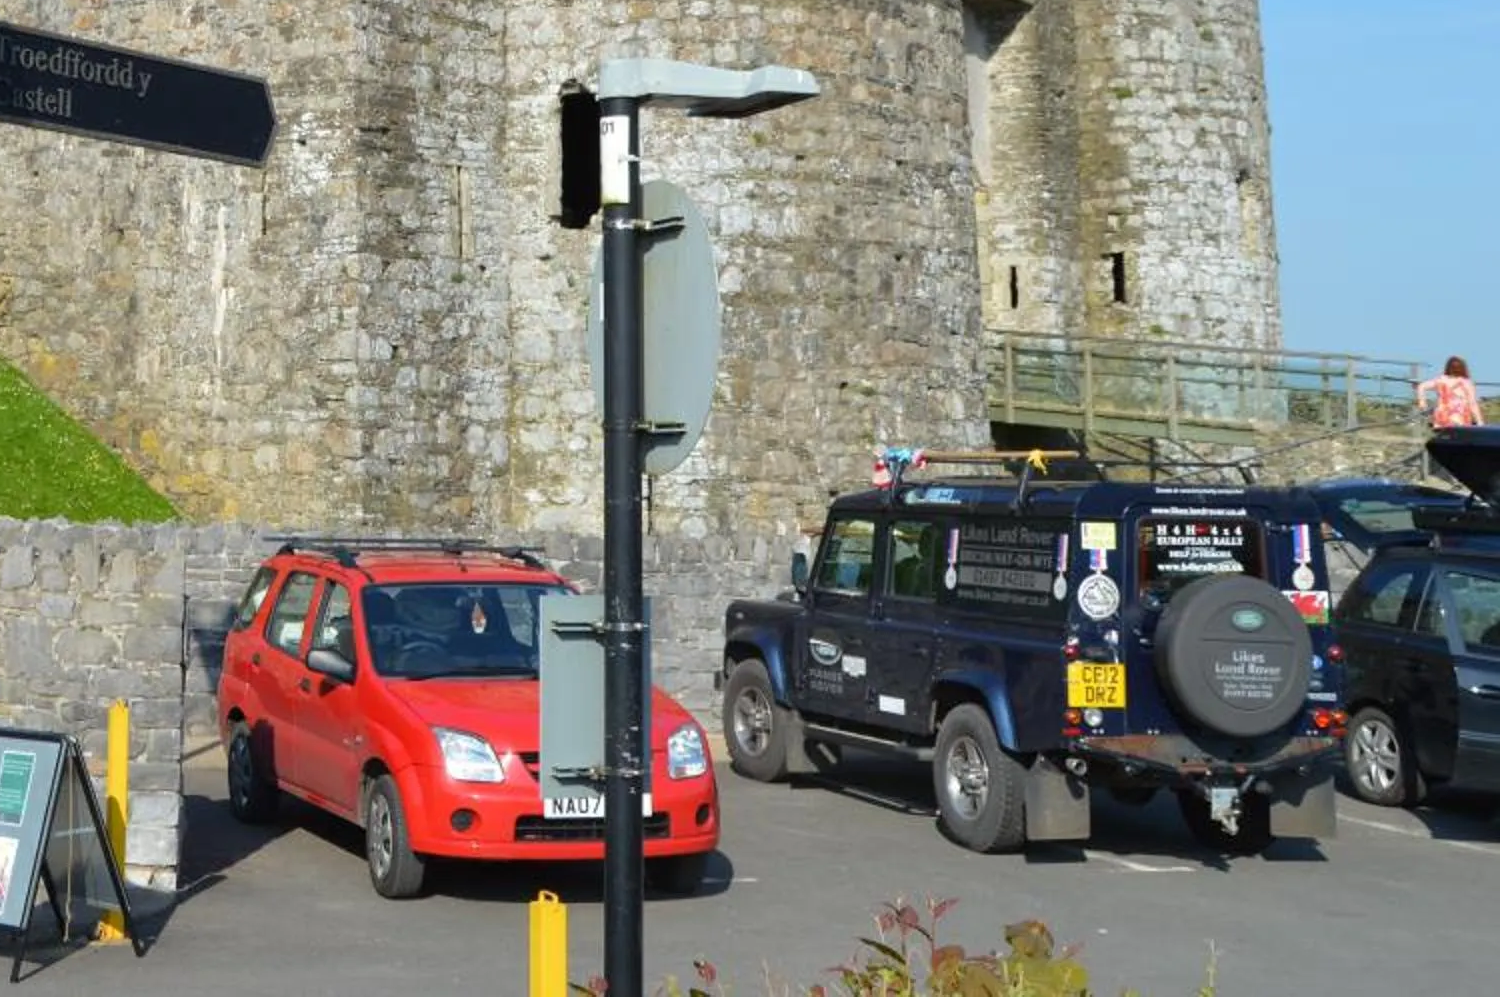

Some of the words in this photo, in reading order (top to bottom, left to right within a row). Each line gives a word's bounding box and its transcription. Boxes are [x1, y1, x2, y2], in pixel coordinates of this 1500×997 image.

[137, 70, 152, 98] y
[1156, 536, 1211, 546] EUROPEAN
[1213, 537, 1244, 546] RALLY
[1232, 651, 1265, 663] Likes
[1215, 662, 1245, 674] Land
[1247, 663, 1281, 675] Rover
